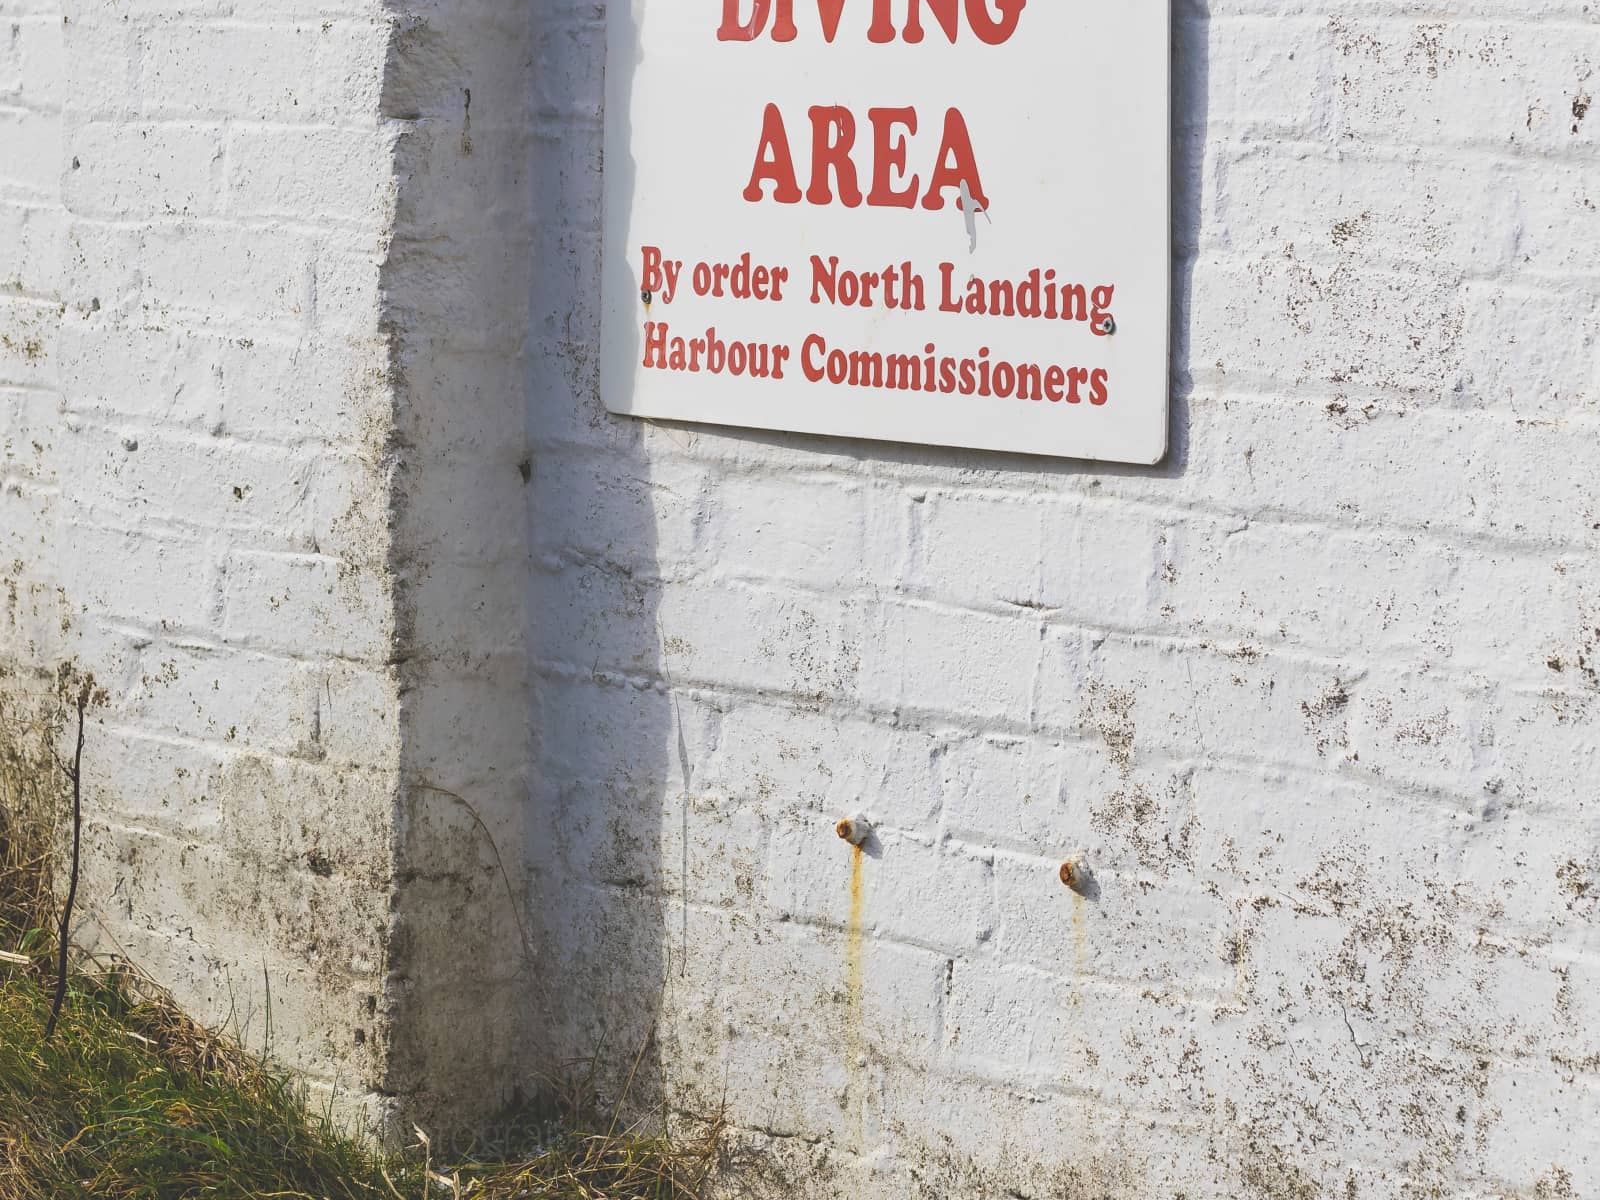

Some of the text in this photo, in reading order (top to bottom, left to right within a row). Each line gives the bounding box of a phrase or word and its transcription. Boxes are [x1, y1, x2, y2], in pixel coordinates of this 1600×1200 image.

[742, 102, 990, 212] AREA
[641, 246, 1115, 337] By order North Landing
[642, 322, 1109, 405] Harbour Commissioners
